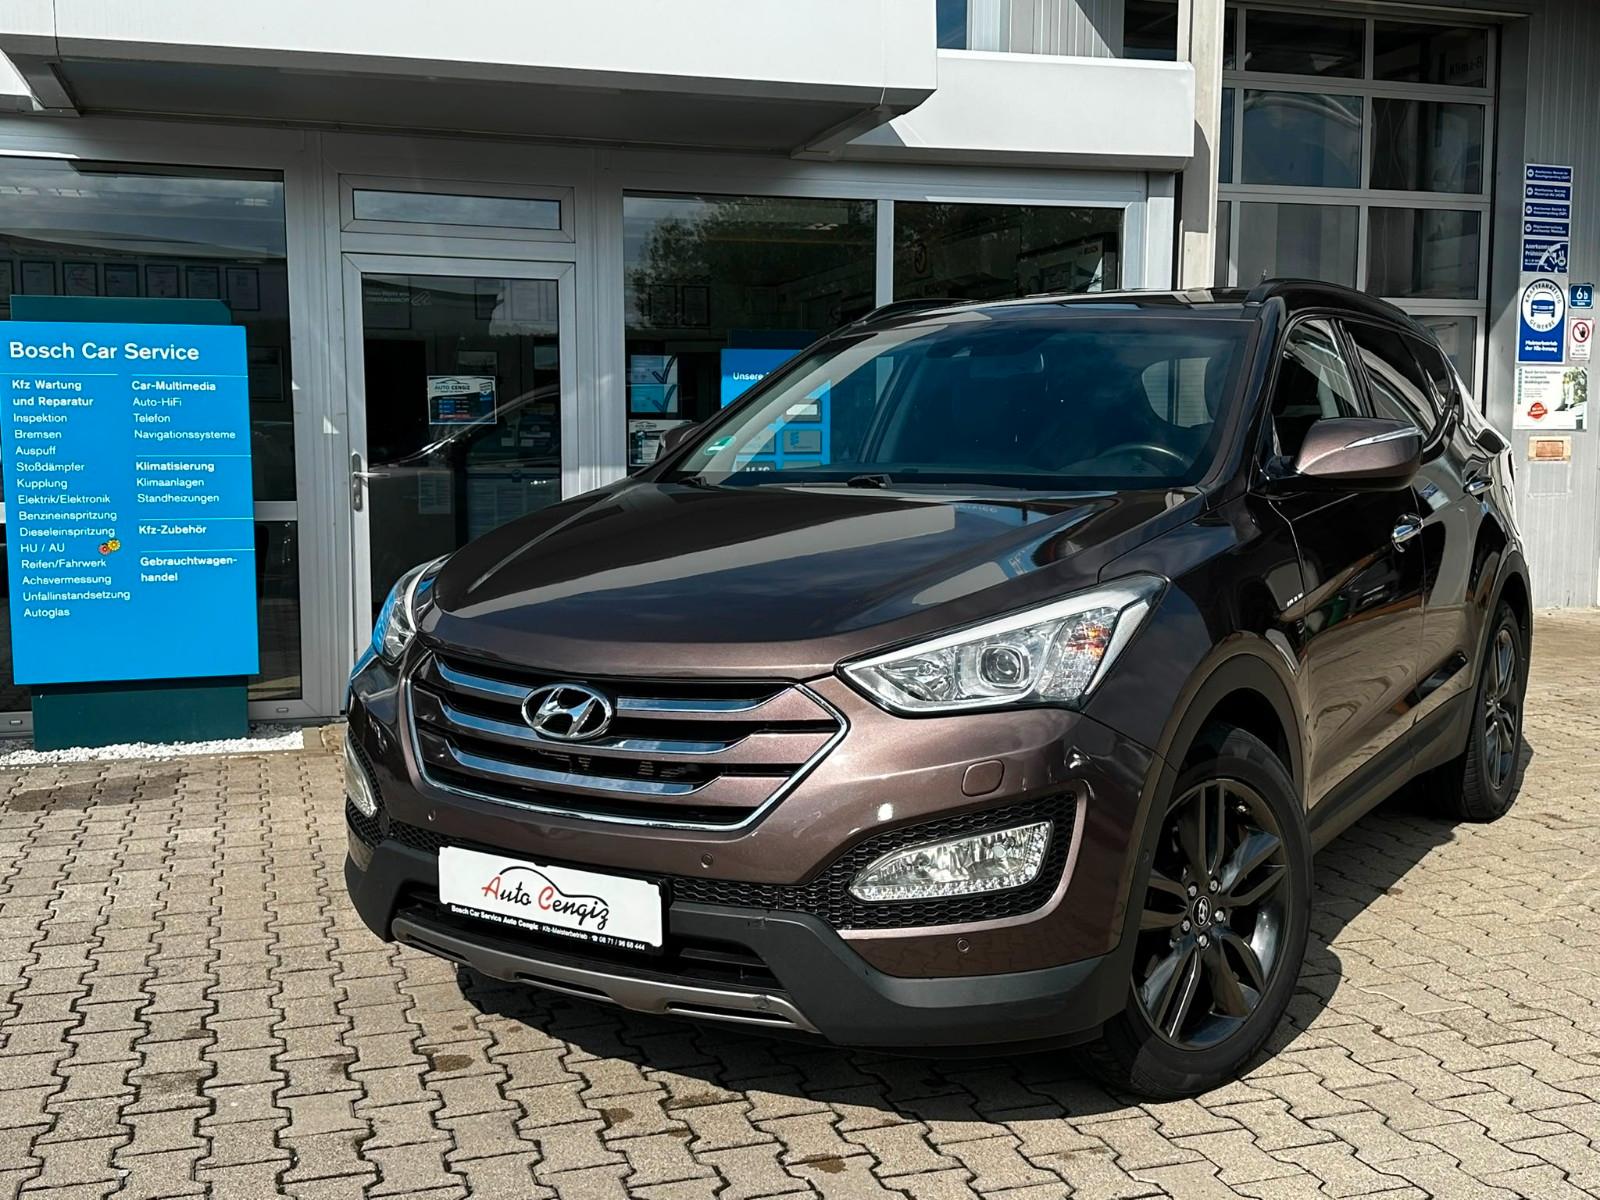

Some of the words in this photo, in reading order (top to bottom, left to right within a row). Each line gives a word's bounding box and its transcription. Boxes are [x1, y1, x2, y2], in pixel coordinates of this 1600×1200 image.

[1576, 288, 1588, 299] 6b
[10, 341, 74, 359] Bosch
[82, 342, 118, 360] Car
[124, 342, 200, 360] Service
[732, 372, 764, 380] Unsere
[12, 380, 30, 390] Kfz
[34, 380, 82, 392] Wartung
[132, 380, 216, 391] Car-Multimedia
[12, 396, 34, 406] und
[38, 396, 94, 408] Reparatur
[132, 397, 182, 407] Auto-HiFi
[13, 413, 68, 424] Inspektion
[132, 414, 171, 423] Telefon
[14, 430, 62, 440] Bremsen
[134, 430, 236, 442] Navigationssysteme
[16, 446, 56, 457] Auspuff
[16, 462, 85, 473] Stoßdämpfer
[136, 462, 216, 472] Klimatisierung
[16, 478, 68, 490] Kupplung
[136, 478, 204, 489] Klimaanlagen
[18, 494, 111, 504] Elektrik/Elektronik
[138, 494, 220, 504] Standheizungen
[18, 510, 118, 522] Benzineinspritzung
[20, 527, 116, 538] Dieseleinspritzung
[138, 525, 208, 535] Kfz-Zubehör
[20, 543, 38, 553] HU
[48, 543, 65, 552] AU
[21, 559, 107, 569] Reifen/Fahrwerk
[140, 556, 238, 568] Gebrauchtwagen-
[22, 575, 112, 586] Achsvermessung
[140, 573, 178, 582] handel
[22, 590, 130, 602] Unfallinstandsetzung
[24, 608, 70, 619] Autoglas
[481, 876, 532, 906] Auto
[538, 886, 610, 930] Cengiz
[451, 905, 469, 915] Bosch
[469, 909, 481, 917] Car
[481, 912, 502, 922] Service
[502, 917, 517, 926] Auto
[518, 920, 539, 931] Cengiz
